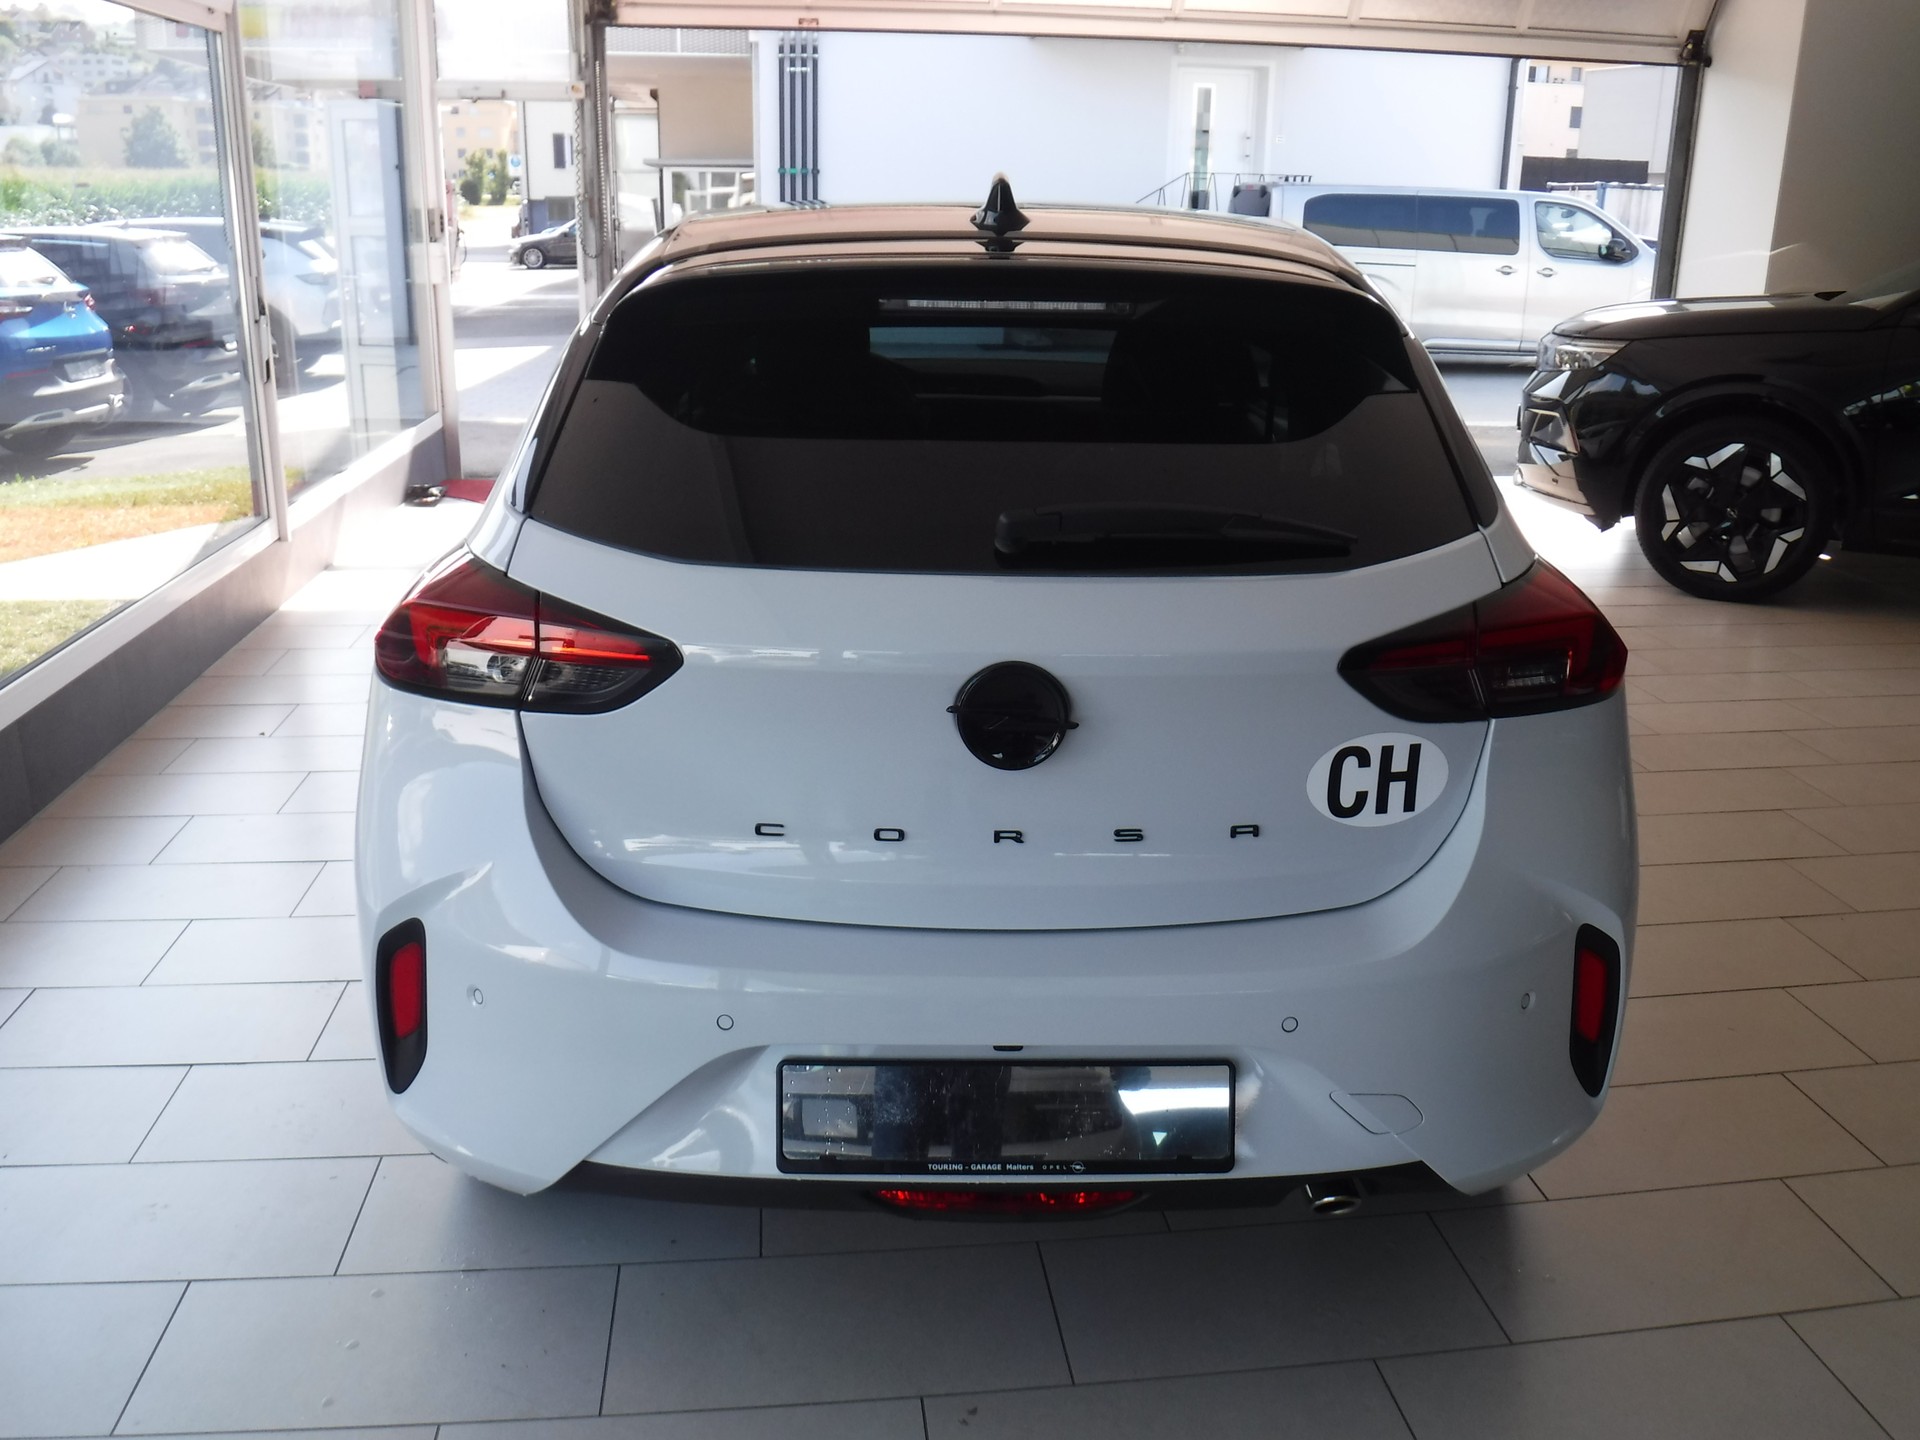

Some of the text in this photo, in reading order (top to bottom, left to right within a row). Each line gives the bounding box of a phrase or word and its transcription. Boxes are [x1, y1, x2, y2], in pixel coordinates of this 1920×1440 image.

[1327, 743, 1422, 819] CH
[754, 822, 1260, 844] CORSA
[927, 1163, 963, 1171] TOURING
[970, 1163, 1002, 1171] GARAGE
